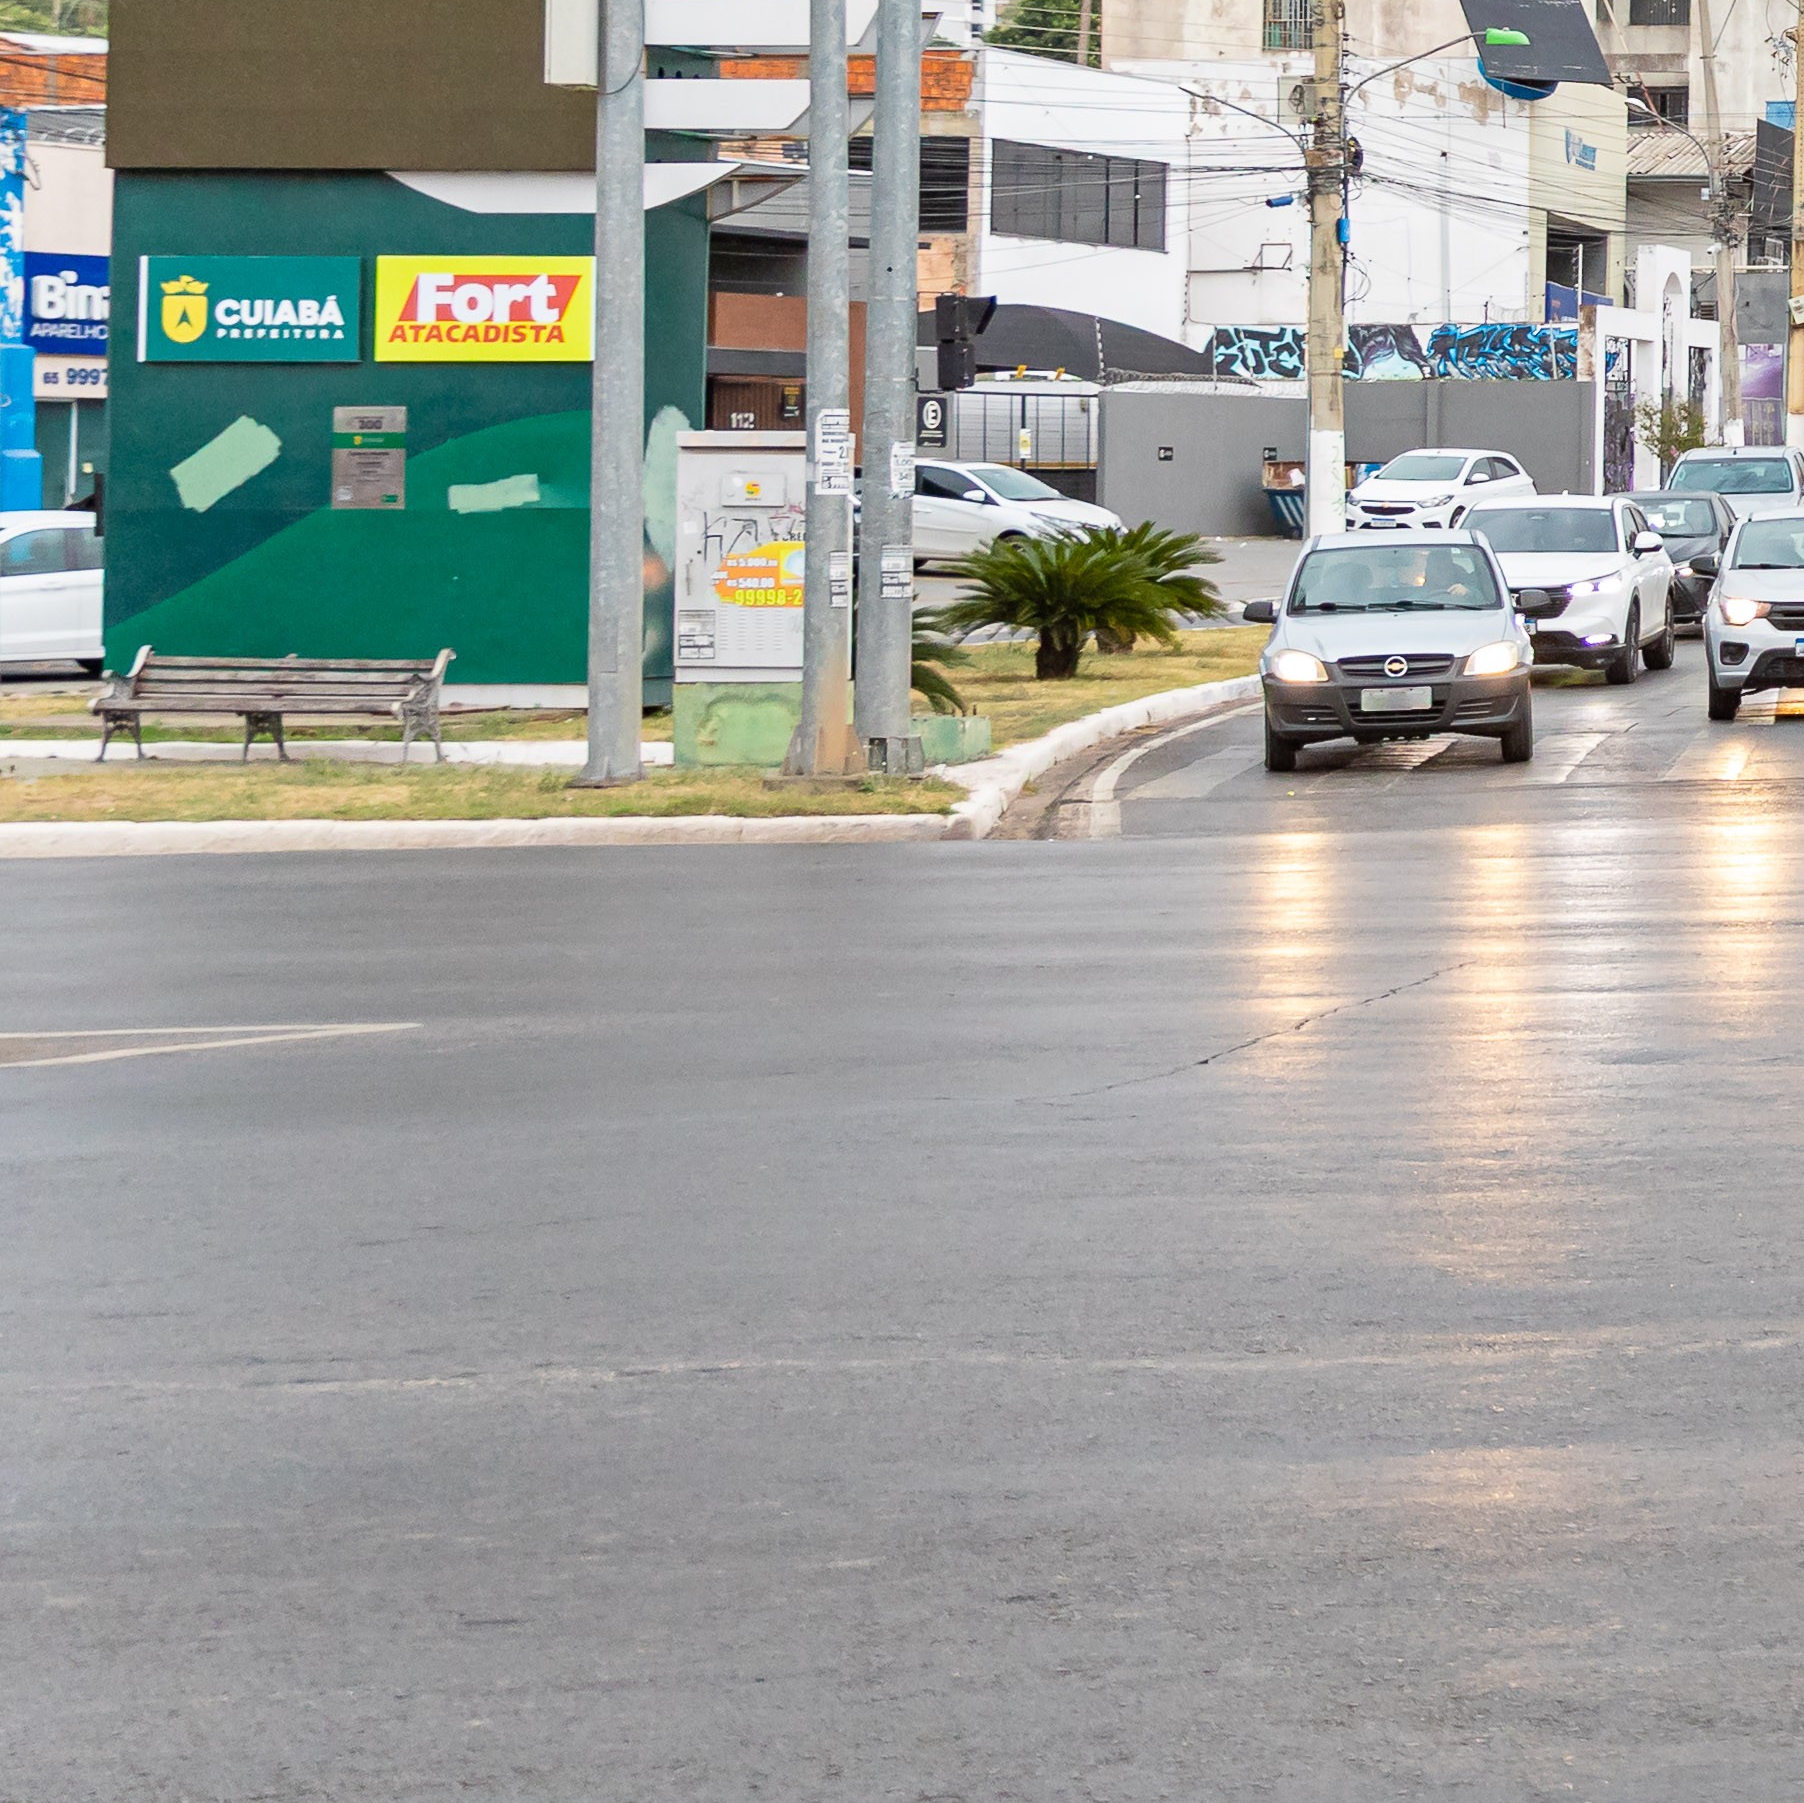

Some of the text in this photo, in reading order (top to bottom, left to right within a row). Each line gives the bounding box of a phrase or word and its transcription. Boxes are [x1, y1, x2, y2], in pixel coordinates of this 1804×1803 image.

[416, 273, 560, 323] Fort
[215, 295, 345, 326] CUIABÁ
[216, 328, 345, 340] PREFEITURA
[388, 325, 566, 344] ATACADISTA
[730, 412, 755, 429] 112
